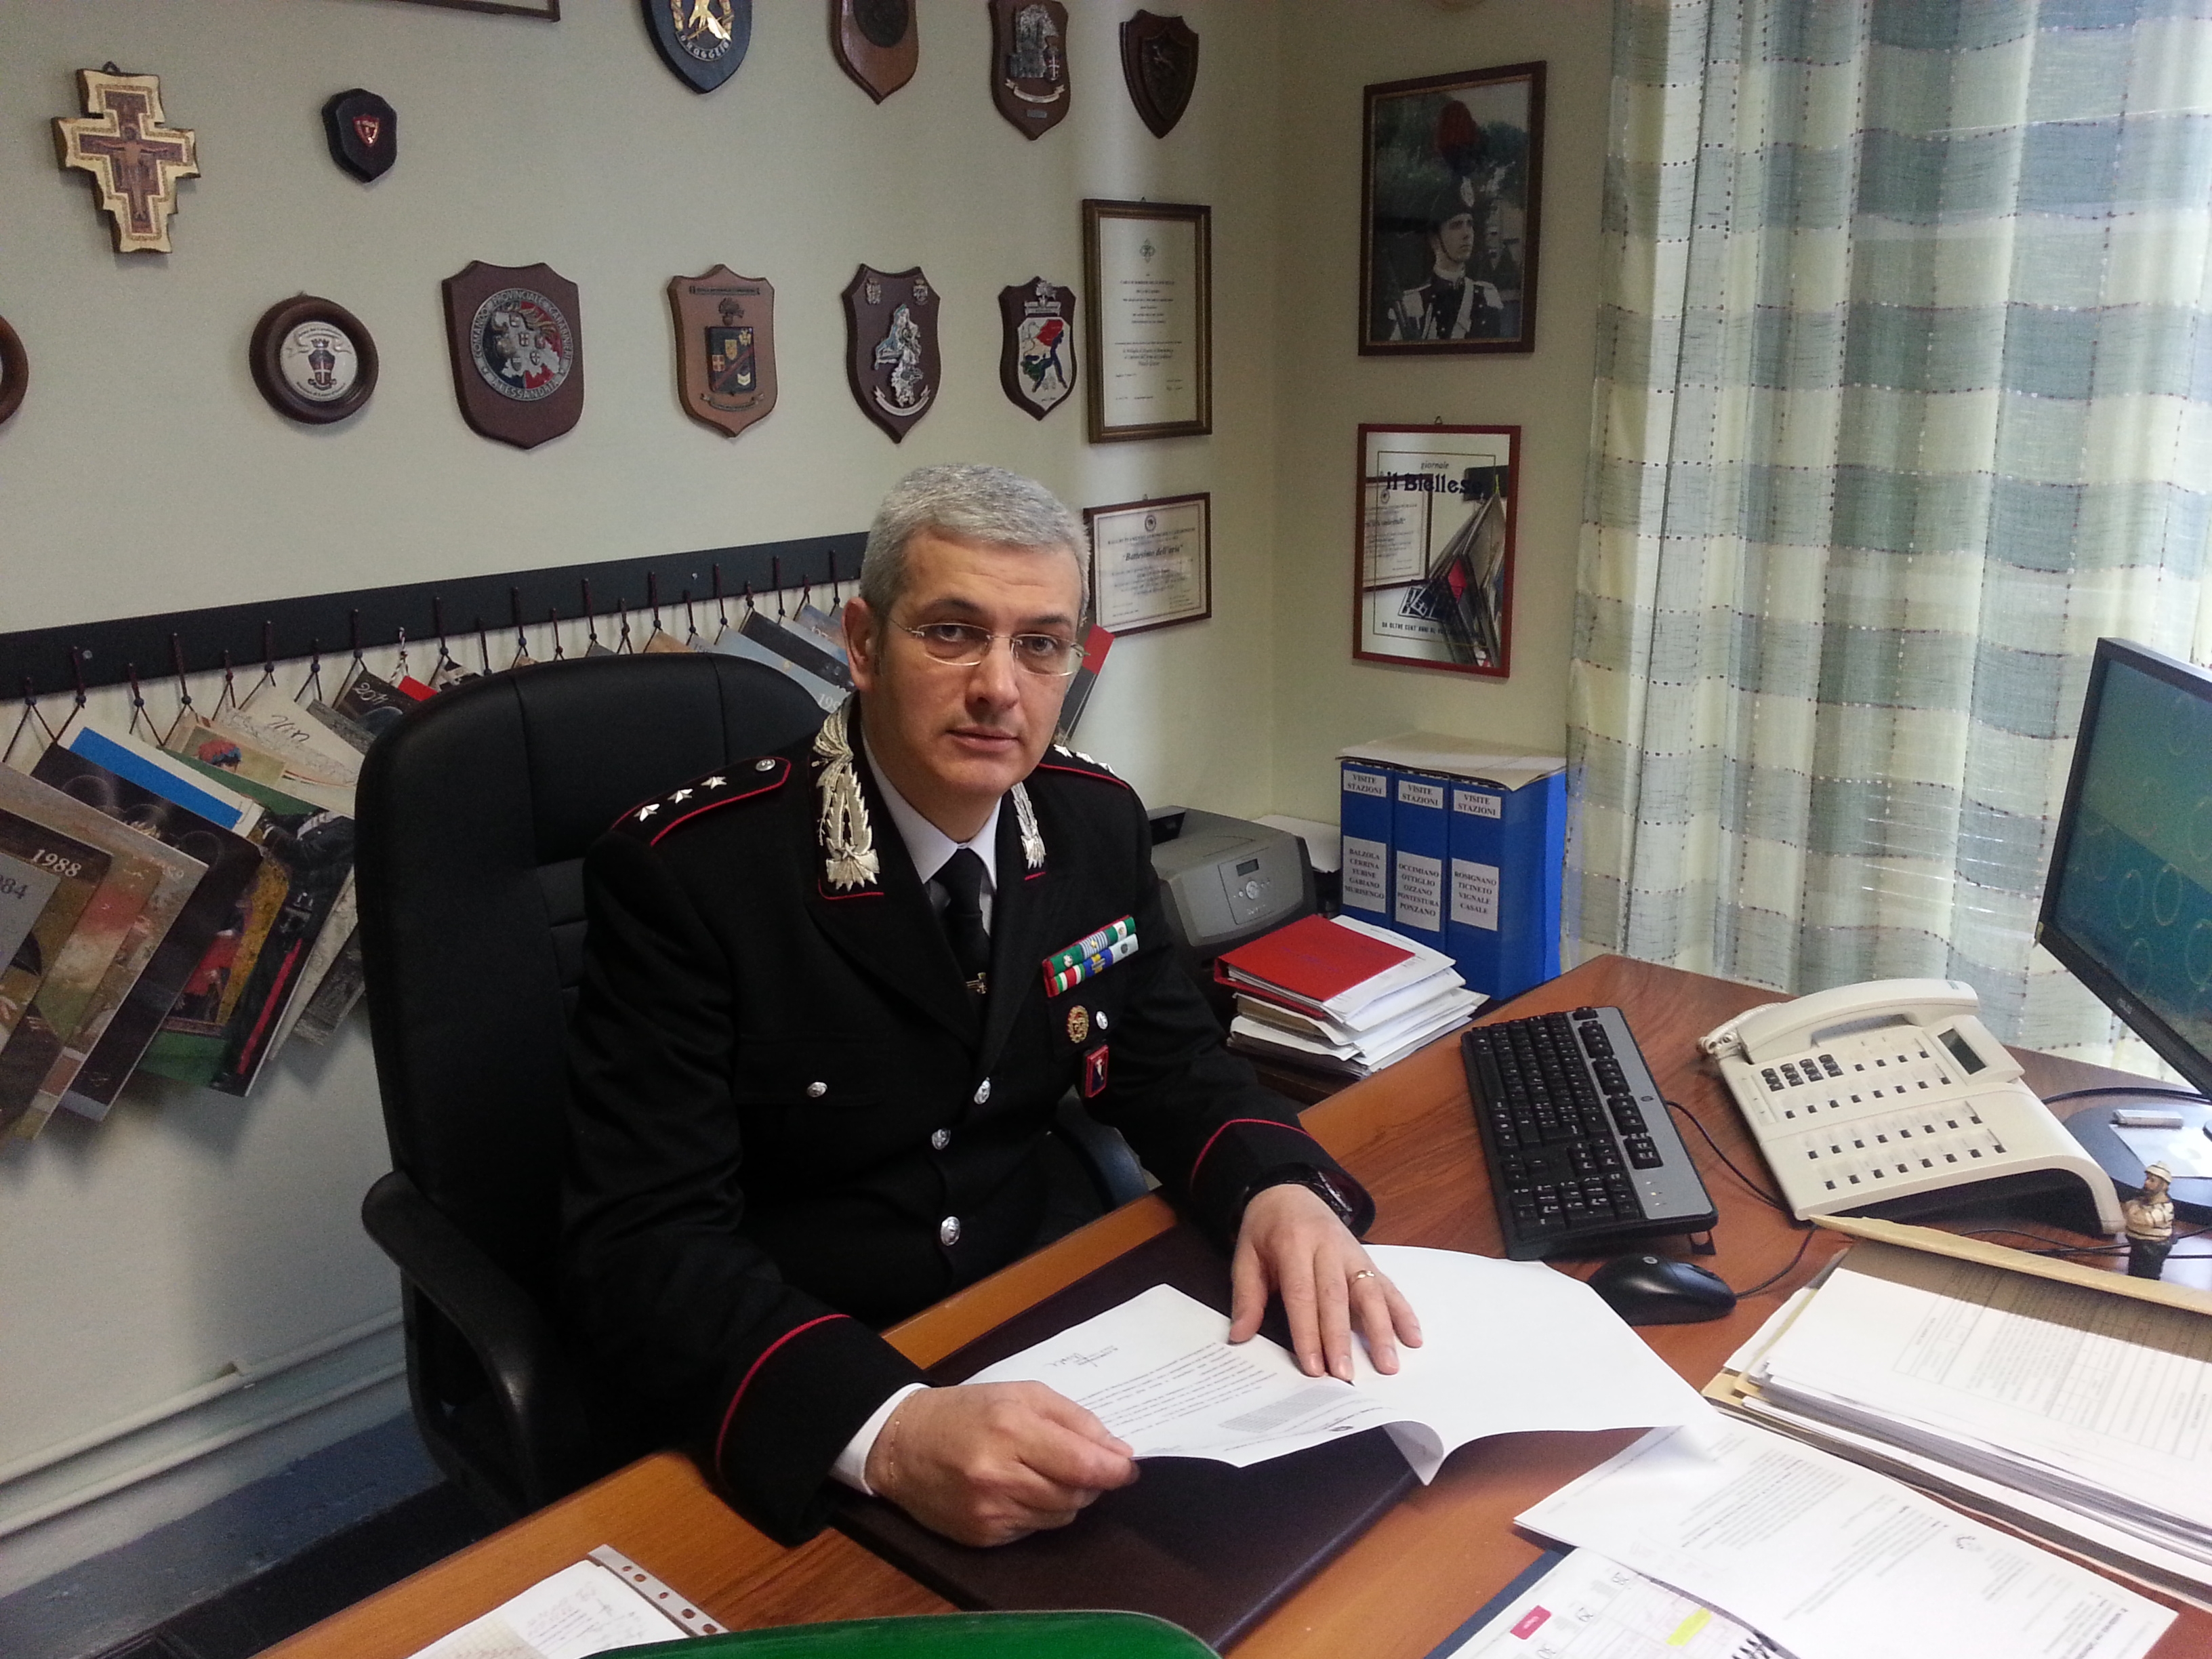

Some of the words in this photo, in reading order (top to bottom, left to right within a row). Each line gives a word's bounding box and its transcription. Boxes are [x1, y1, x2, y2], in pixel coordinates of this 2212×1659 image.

[473, 308, 489, 359] COMANDO
[493, 291, 544, 305] PROVINCIALE
[549, 305, 571, 361] CARABINIERI
[492, 378, 560, 398] ALESSANDRIA
[1420, 459, 1450, 471] giornale
[1353, 774, 1376, 784] VISITE
[1347, 783, 1382, 795] STAZIONI
[1408, 784, 1433, 795] VISITE
[1402, 793, 1439, 806] STAZIONI
[1464, 794, 1490, 804] VISITE
[1458, 802, 1496, 816] STAZIONI
[1349, 848, 1380, 860] BALZOLA
[32, 848, 82, 878] 1988
[1349, 858, 1380, 869] CERRINA
[1399, 863, 1439, 878] OCCIMIANO
[1349, 877, 1380, 888] GABIANO
[1401, 874, 1435, 886] OTTIGLIO
[1454, 871, 1497, 886] ROSIGNANO
[0, 875, 28, 899] 84
[1404, 884, 1433, 896] OZZANO
[1458, 882, 1492, 895] TICINETO
[1397, 892, 1439, 907] PONTESTURA
[1458, 892, 1490, 904] VIGNALE
[1400, 902, 1436, 916] PONZANO
[1460, 903, 1488, 914] CASALE
